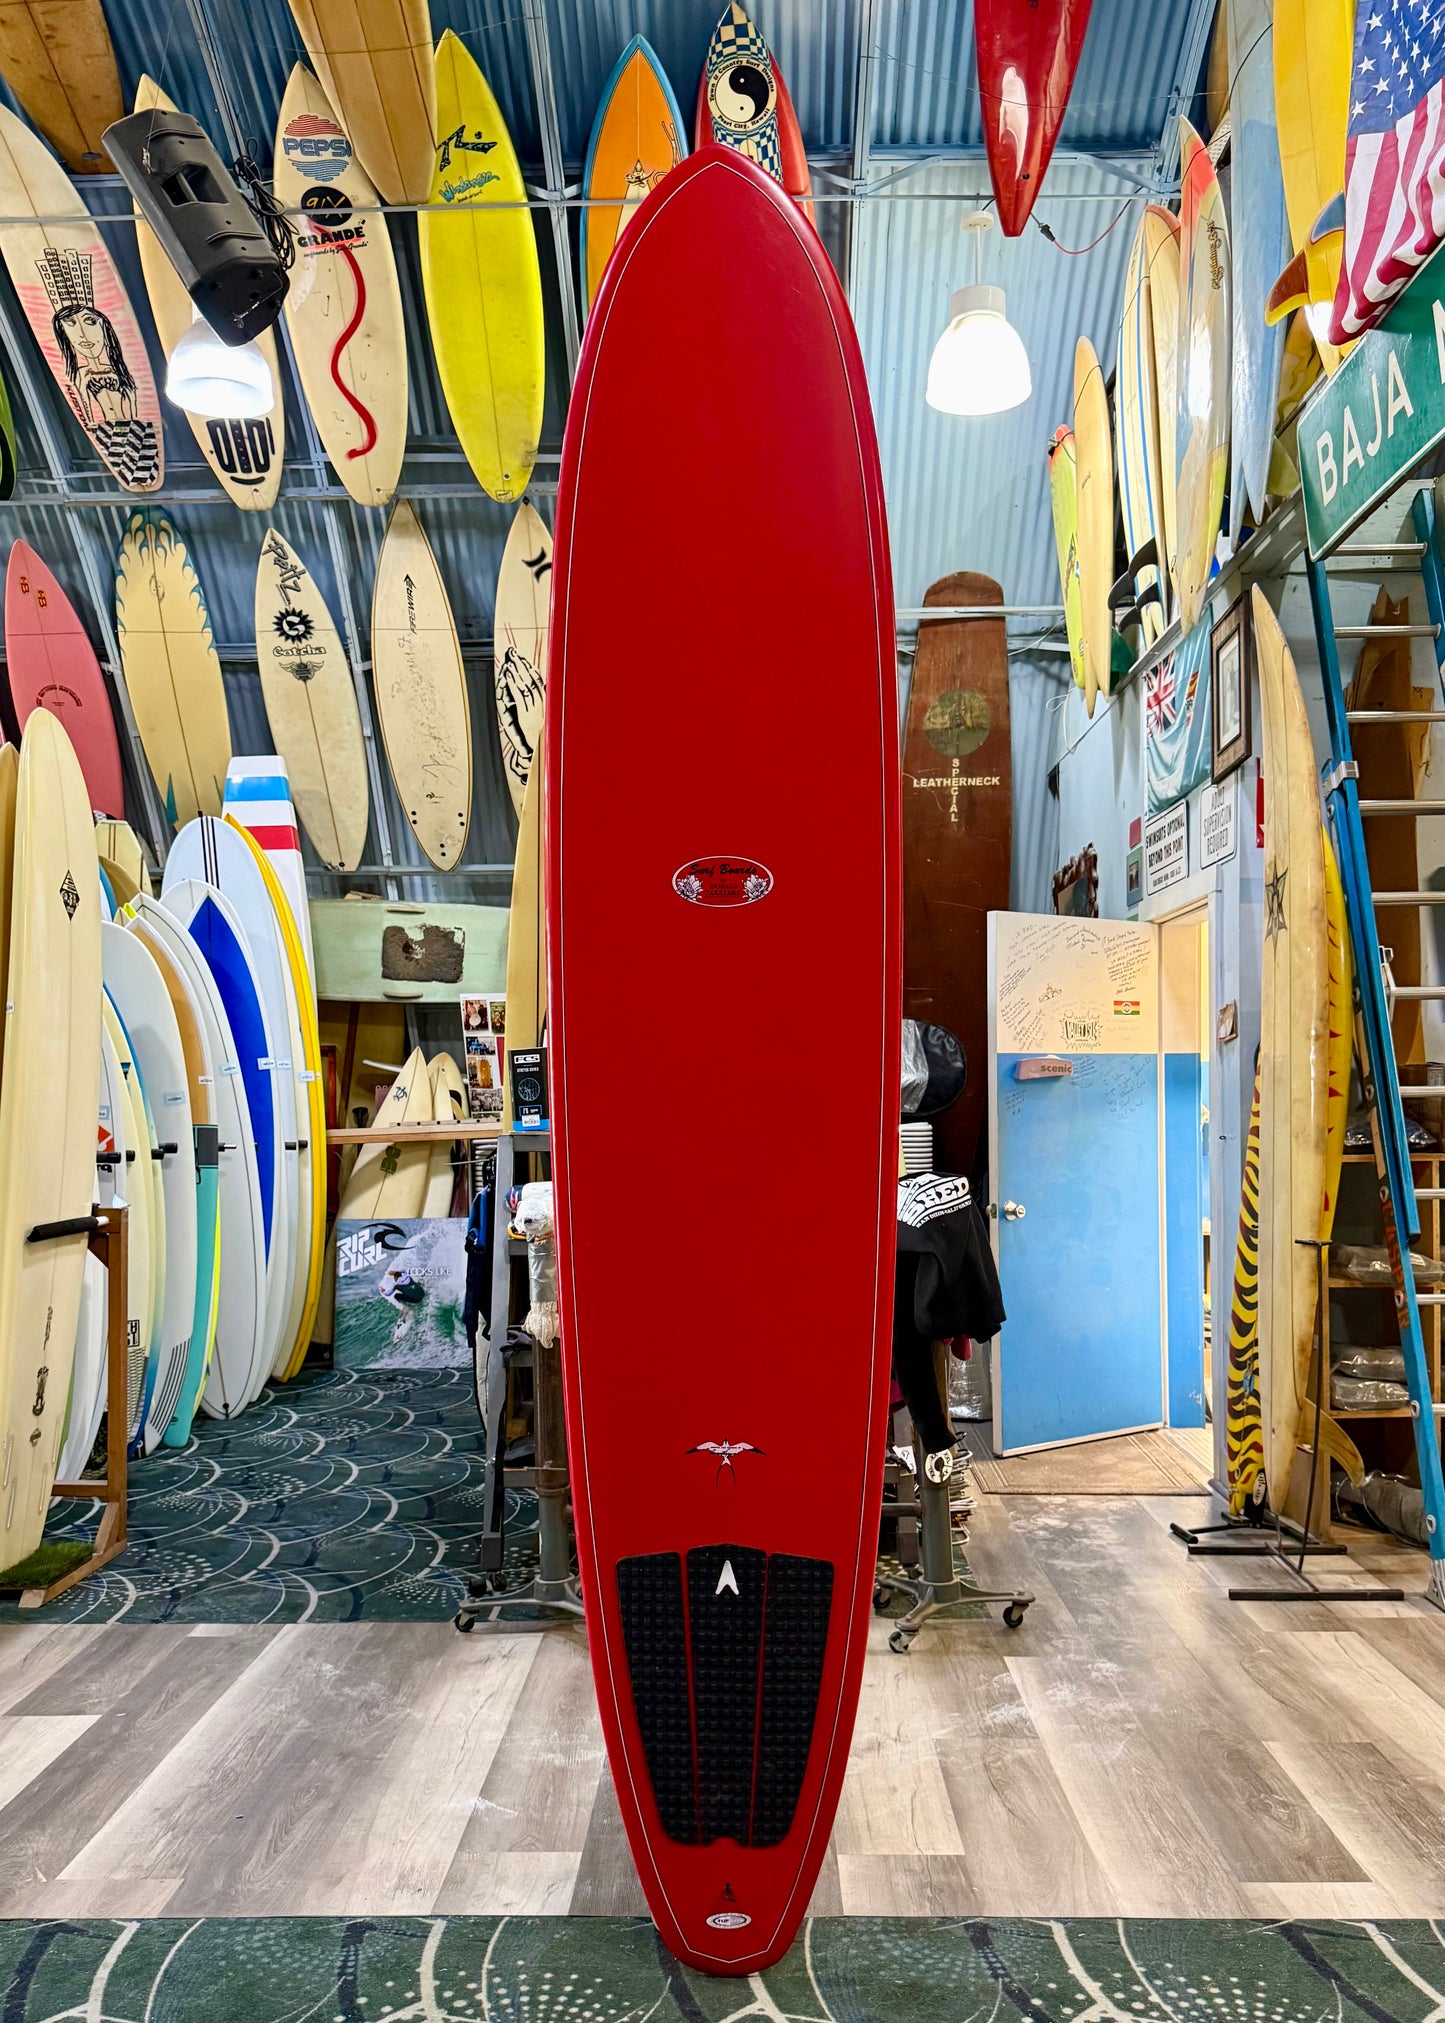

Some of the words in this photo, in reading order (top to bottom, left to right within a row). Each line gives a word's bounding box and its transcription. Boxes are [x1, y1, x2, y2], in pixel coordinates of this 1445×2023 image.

[718, 60, 743, 74] Country
[746, 60, 760, 69] Surf
[761, 68, 775, 93] Designs
[1316, 350, 1414, 507] BAJA
[273, 645, 327, 657] Gotcha
[913, 776, 1000, 788] LEATHERNECK
[949, 758, 960, 822] SPECIAL
[688, 863, 715, 877] Surf
[720, 864, 756, 875] Boards
[515, 1055, 539, 1063] FCS
[1040, 1063, 1072, 1073] scenic
[337, 1228, 370, 1258] RIP
[339, 1242, 388, 1277] CURL
[407, 1267, 433, 1276] LOOKS
[435, 1267, 452, 1276] LIKE
